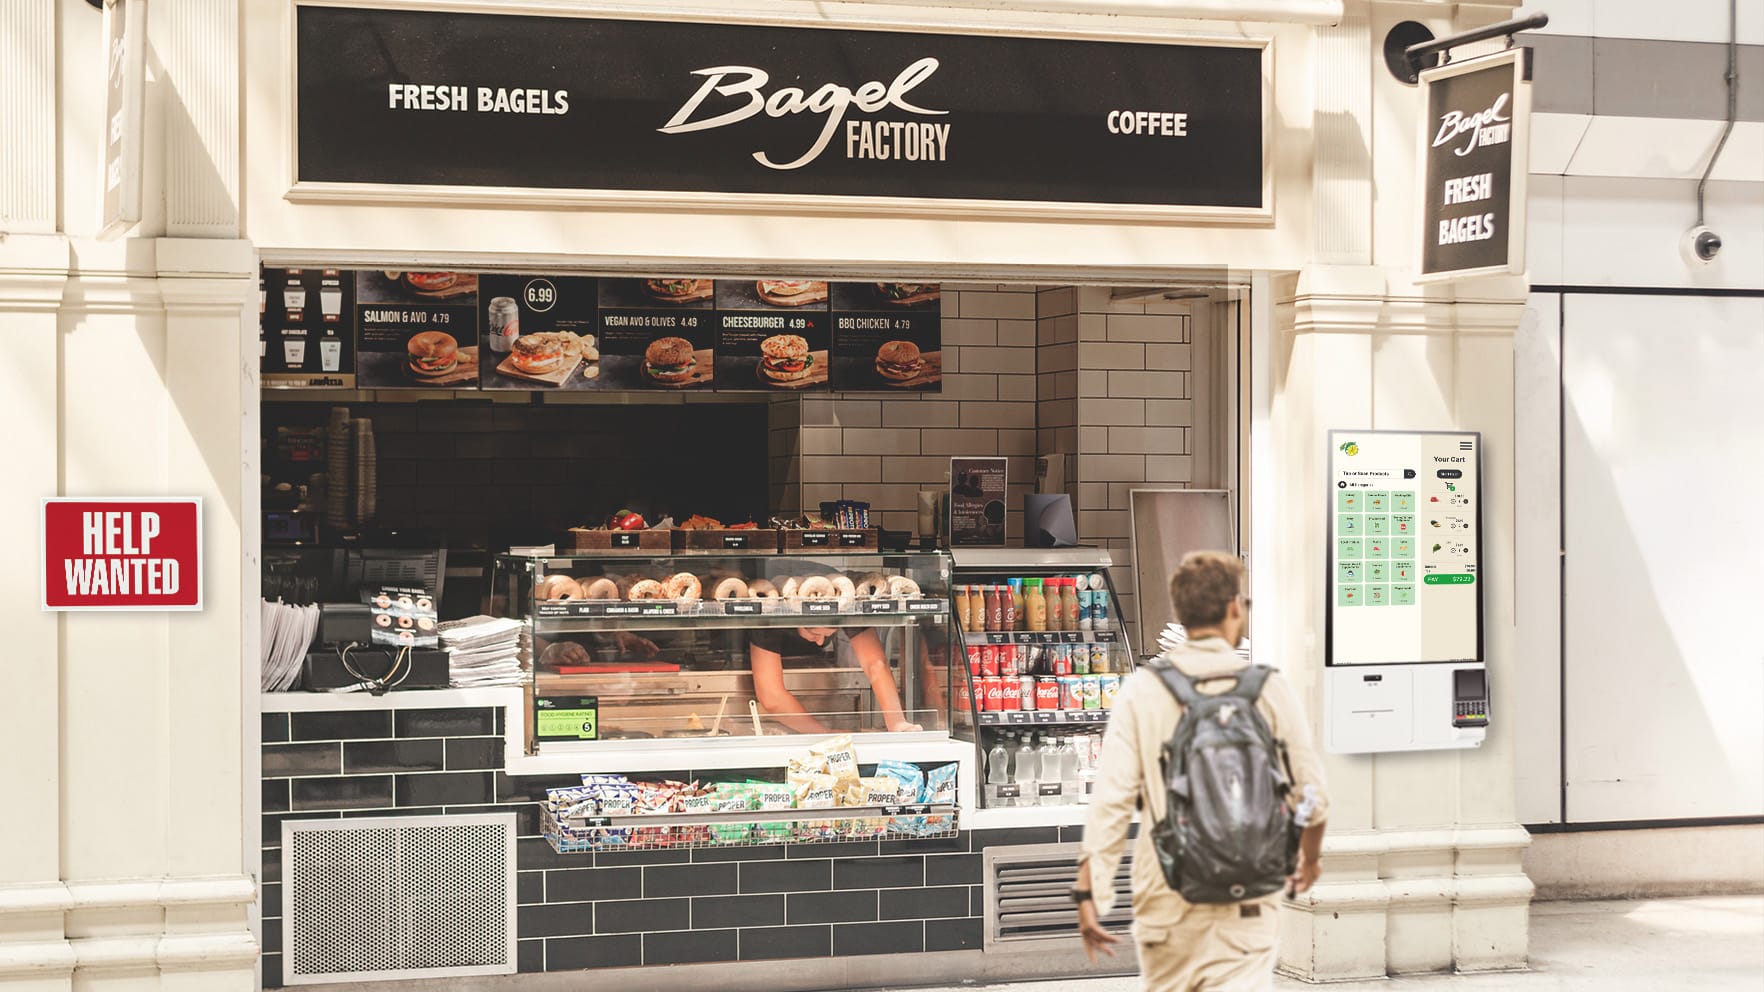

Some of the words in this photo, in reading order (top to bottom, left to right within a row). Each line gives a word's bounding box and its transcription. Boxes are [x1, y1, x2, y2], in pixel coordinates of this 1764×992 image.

[388, 83, 468, 111] FRESH
[476, 87, 569, 115] BAGELS
[656, 57, 950, 170] Bagel
[1107, 110, 1188, 137] COFFEE
[1432, 92, 1511, 157] Bagel
[846, 120, 951, 162] FACTORY
[1478, 122, 1511, 147] FACTORY
[1444, 172, 1493, 206] FRESH
[1438, 212, 1495, 246] BAGELS
[528, 287, 553, 303] 6.99
[364, 310, 400, 323] SALMON
[402, 311, 409, 323] &
[410, 311, 427, 323] AVO
[432, 313, 450, 324] 4.79
[604, 316, 629, 328] VEGAN
[629, 316, 644, 328] AVO
[644, 316, 651, 328] &
[651, 317, 676, 328] OLIVES
[680, 317, 698, 328] 4.49
[722, 316, 785, 328] CHEESEBURGER
[789, 318, 806, 329] 4.99
[838, 317, 855, 330] BBQ
[856, 318, 890, 329] CHICKEN
[894, 319, 910, 330] 4.79
[82, 511, 161, 555] HELP
[64, 558, 180, 596] WANTED
[584, 723, 590, 732] 5
[604, 799, 631, 810] PROPER
[684, 797, 710, 808] PROPER
[718, 800, 745, 811] PROPER
[764, 793, 790, 803] PROPER
[868, 793, 896, 804] PROPER
